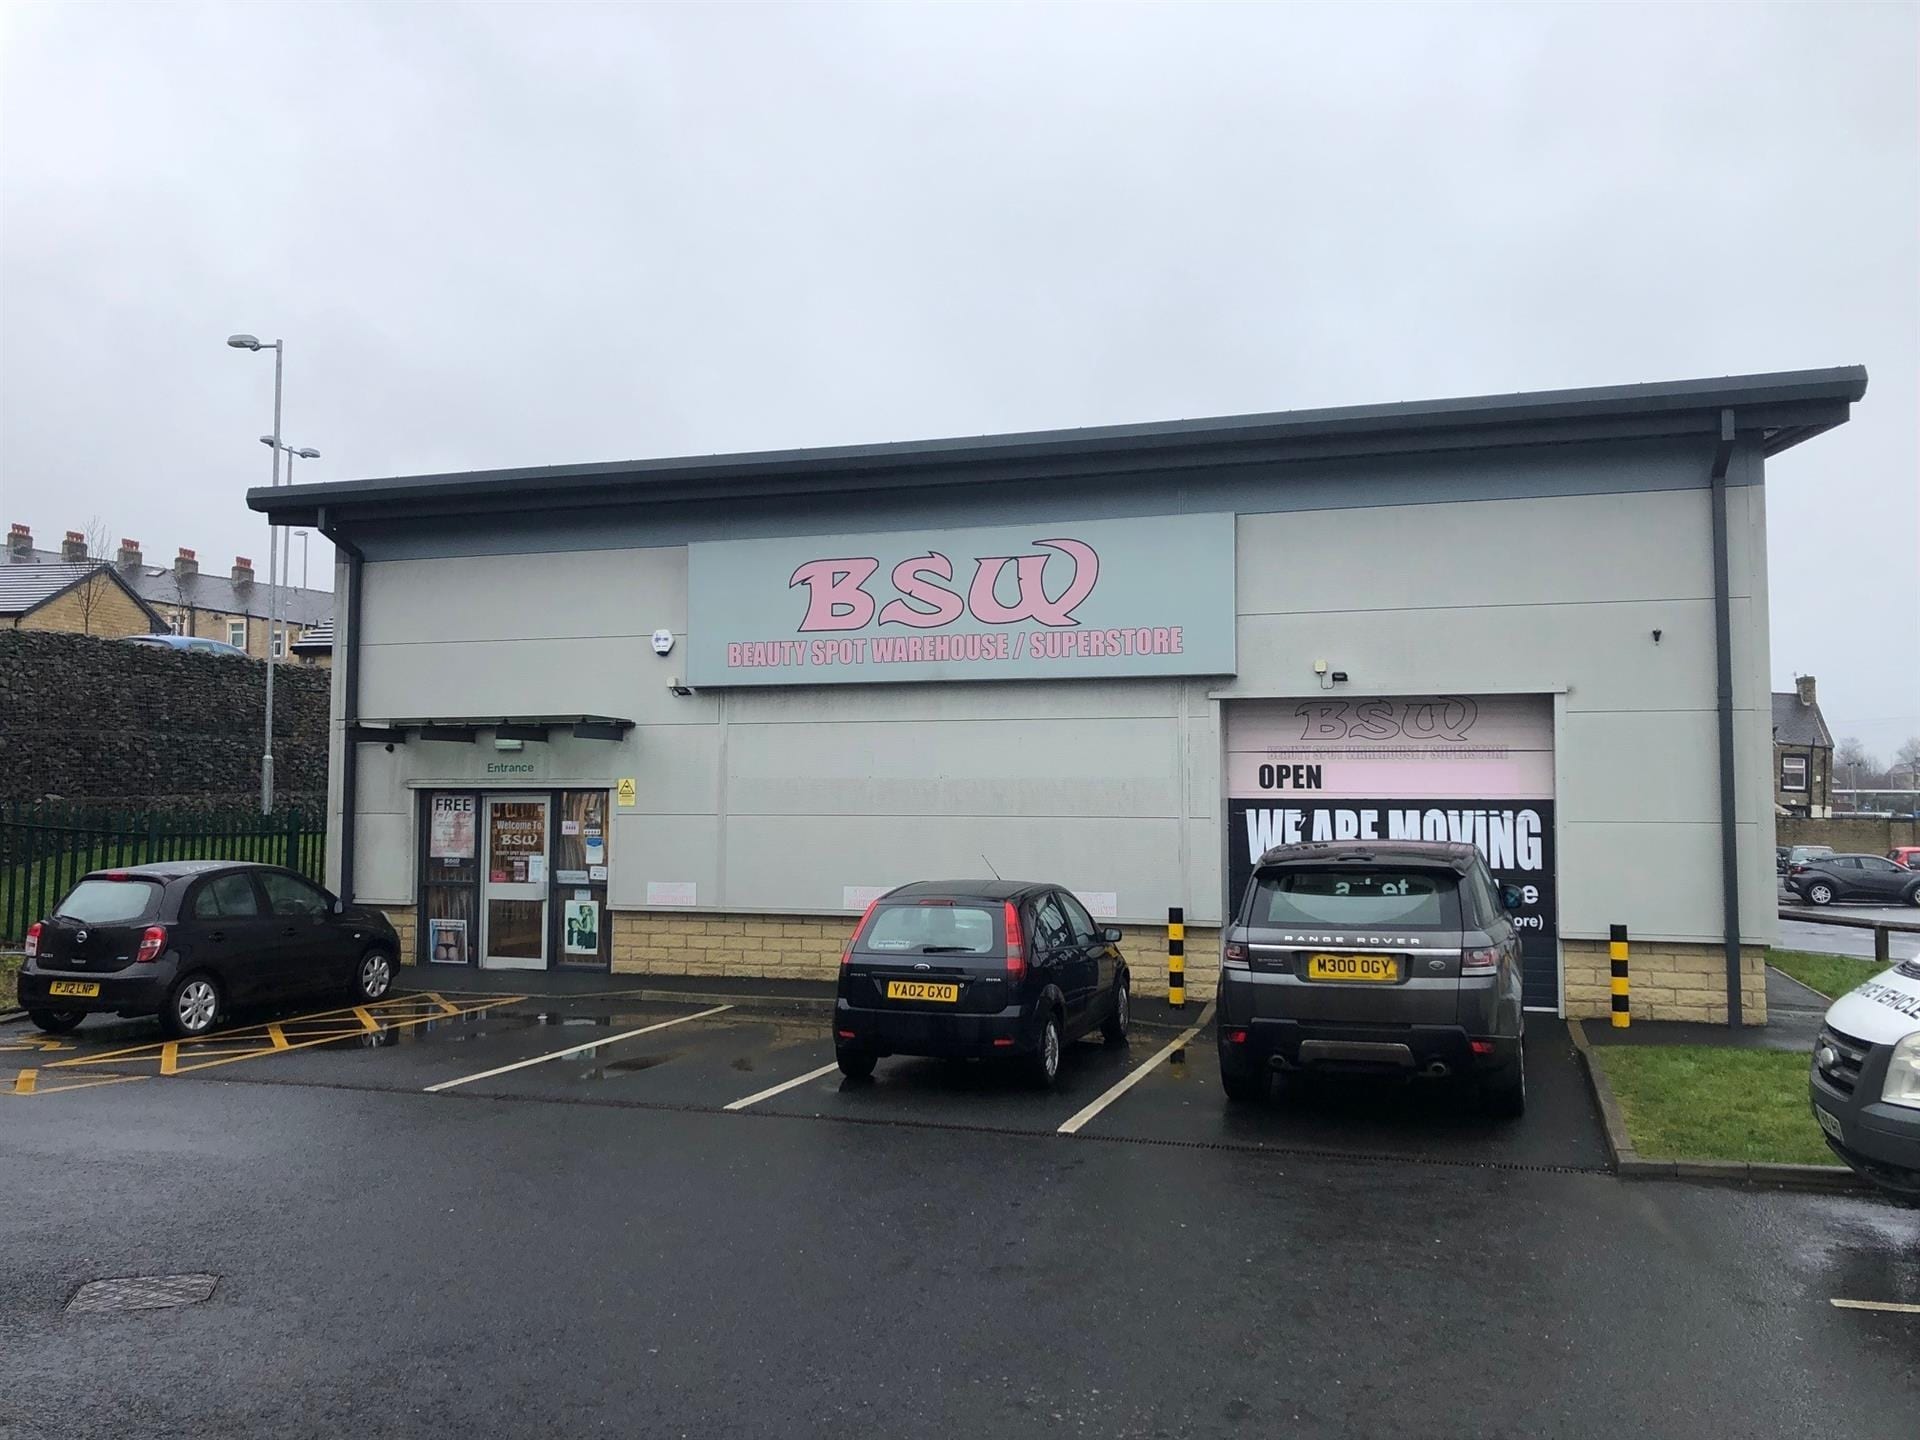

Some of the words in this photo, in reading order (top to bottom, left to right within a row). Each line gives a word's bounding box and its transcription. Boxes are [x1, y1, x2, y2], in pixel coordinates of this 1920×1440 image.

[789, 538, 1100, 632] BSW
[728, 641, 807, 667] BEAUTY
[811, 638, 866, 665] SPOT
[871, 632, 1008, 662] WAREHOUSE
[1013, 632, 1026, 659] /
[1030, 626, 1183, 658] SUPERSTORE
[1295, 695, 1478, 741] BSW
[487, 763, 534, 773] Entrance
[1259, 764, 1322, 789] OPEN
[436, 798, 471, 811] FREE
[496, 820, 531, 830] Welcome
[501, 832, 538, 846] BSW
[1246, 808, 1302, 864] WE
[1284, 935, 1344, 943] RANGE
[1357, 937, 1420, 945] ROVER
[1317, 959, 1356, 973] M300
[893, 983, 925, 997] YA02
